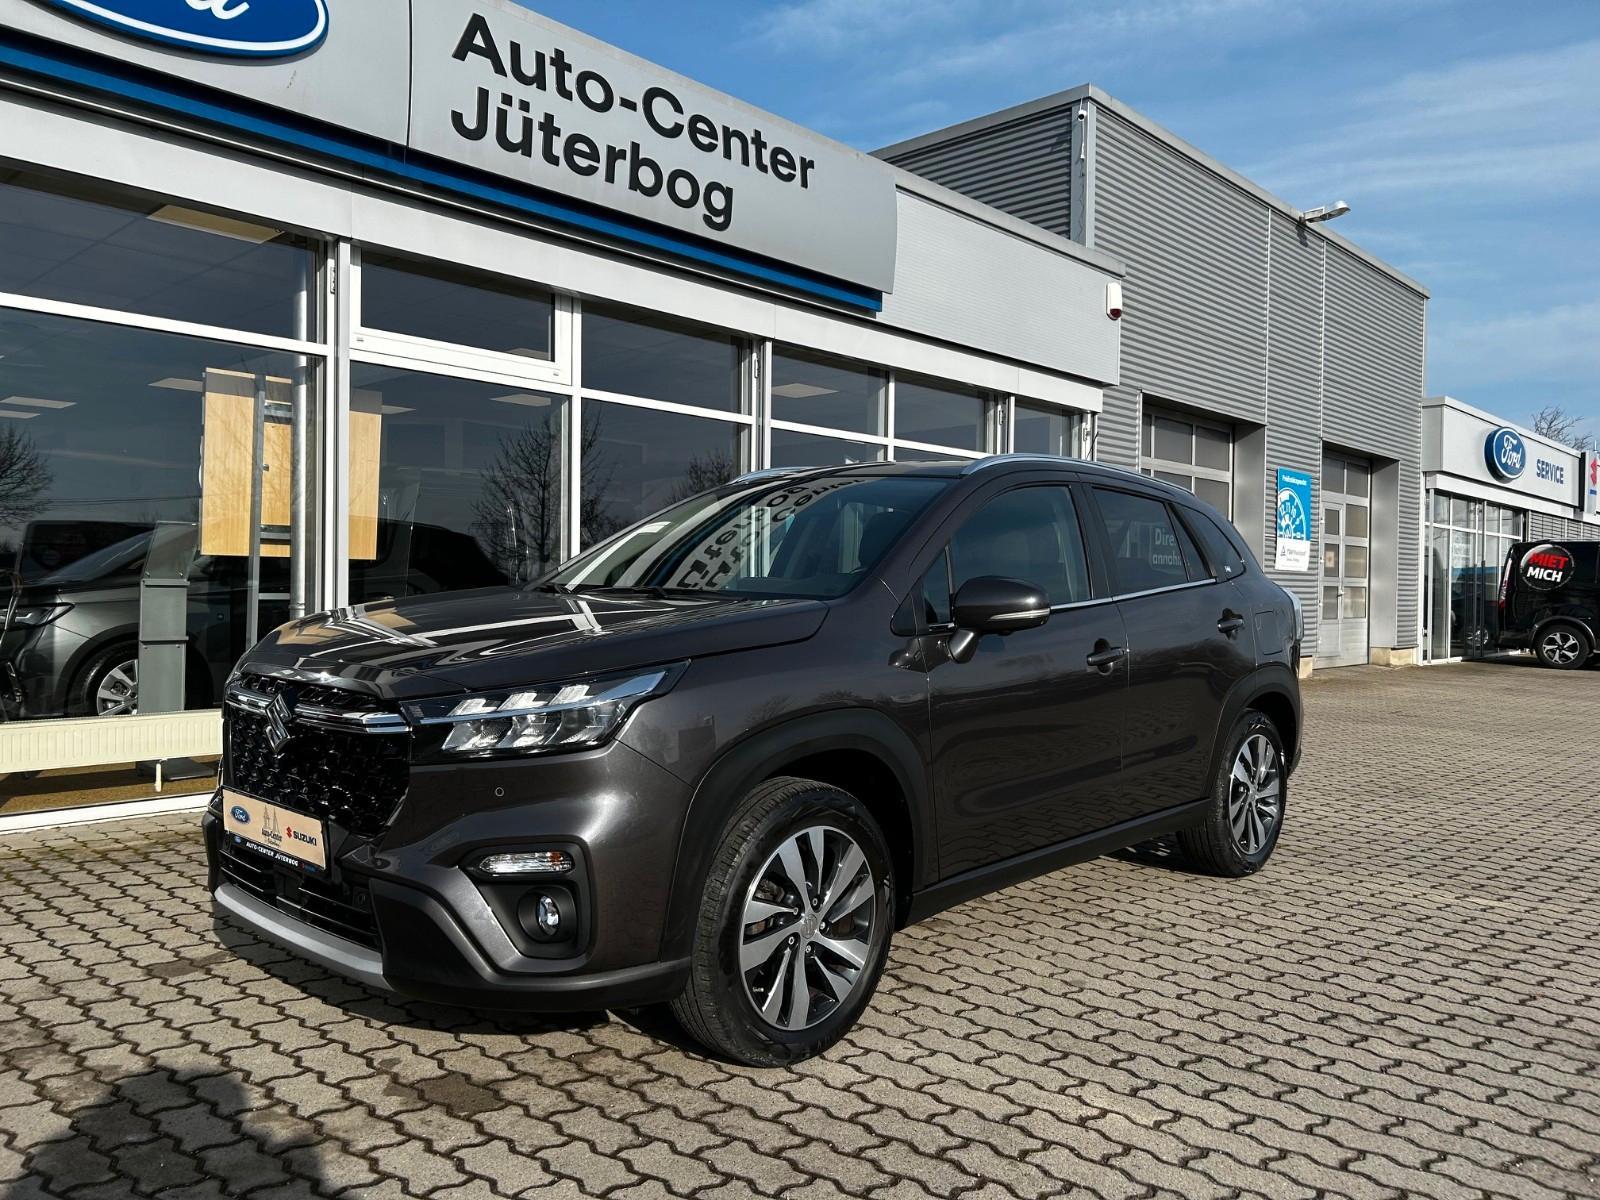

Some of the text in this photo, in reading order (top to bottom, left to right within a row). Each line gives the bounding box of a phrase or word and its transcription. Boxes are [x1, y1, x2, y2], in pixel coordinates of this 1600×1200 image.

[452, 13, 815, 190] Auto-Center
[450, 87, 735, 232] Jüterbog
[1501, 434, 1523, 469] Ford
[1536, 458, 1564, 485] SERVICE
[1155, 527, 1177, 546] Dire
[1528, 552, 1569, 569] MIET
[1526, 566, 1563, 583] MICH
[293, 830, 317, 847] SUZUKI
[245, 841, 274, 859] AUTO-CENTER
